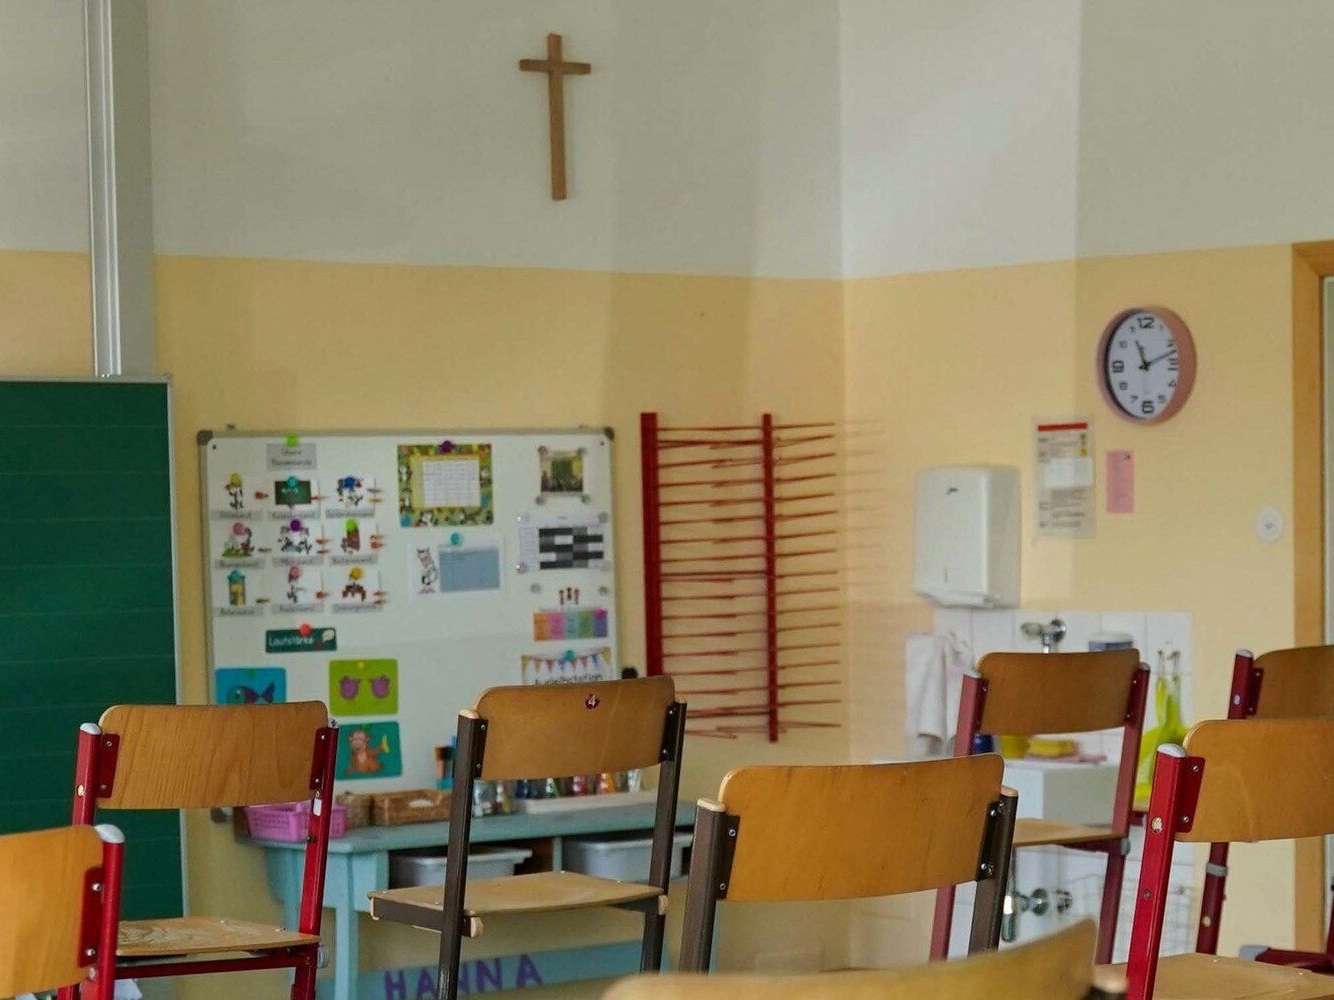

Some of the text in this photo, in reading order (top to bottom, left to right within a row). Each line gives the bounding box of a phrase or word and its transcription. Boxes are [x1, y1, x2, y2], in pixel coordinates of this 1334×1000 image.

[1137, 316, 1155, 329] 12
[1112, 360, 1124, 374] 9
[1141, 400, 1155, 414] 6
[588, 694, 597, 706] 4
